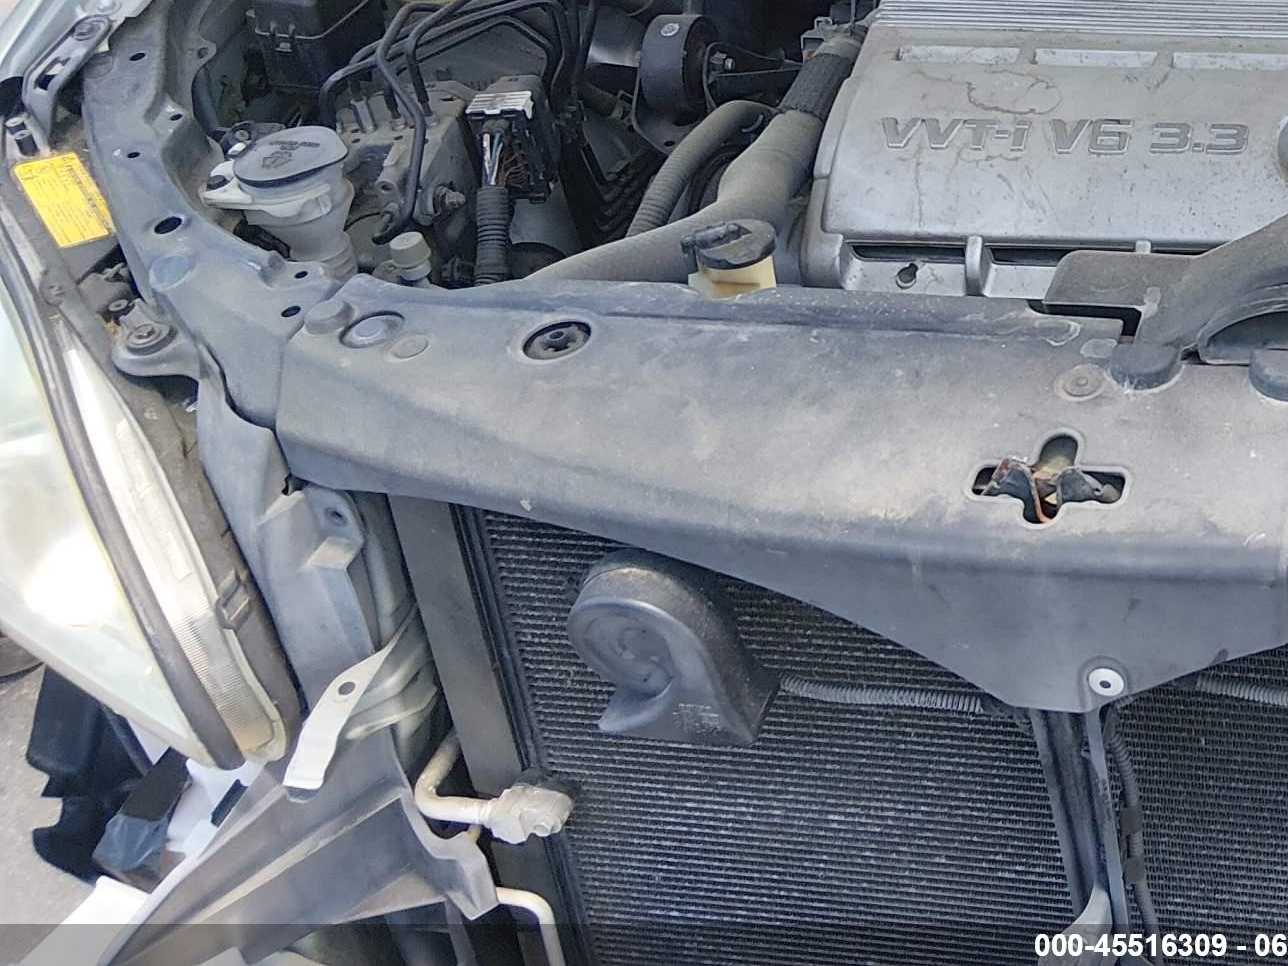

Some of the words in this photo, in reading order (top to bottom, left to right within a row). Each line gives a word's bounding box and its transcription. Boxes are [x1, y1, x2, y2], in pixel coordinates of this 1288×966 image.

[881, 117, 1031, 151] VVT-i
[1051, 118, 1134, 155] V6
[1149, 122, 1249, 155] 3.3
